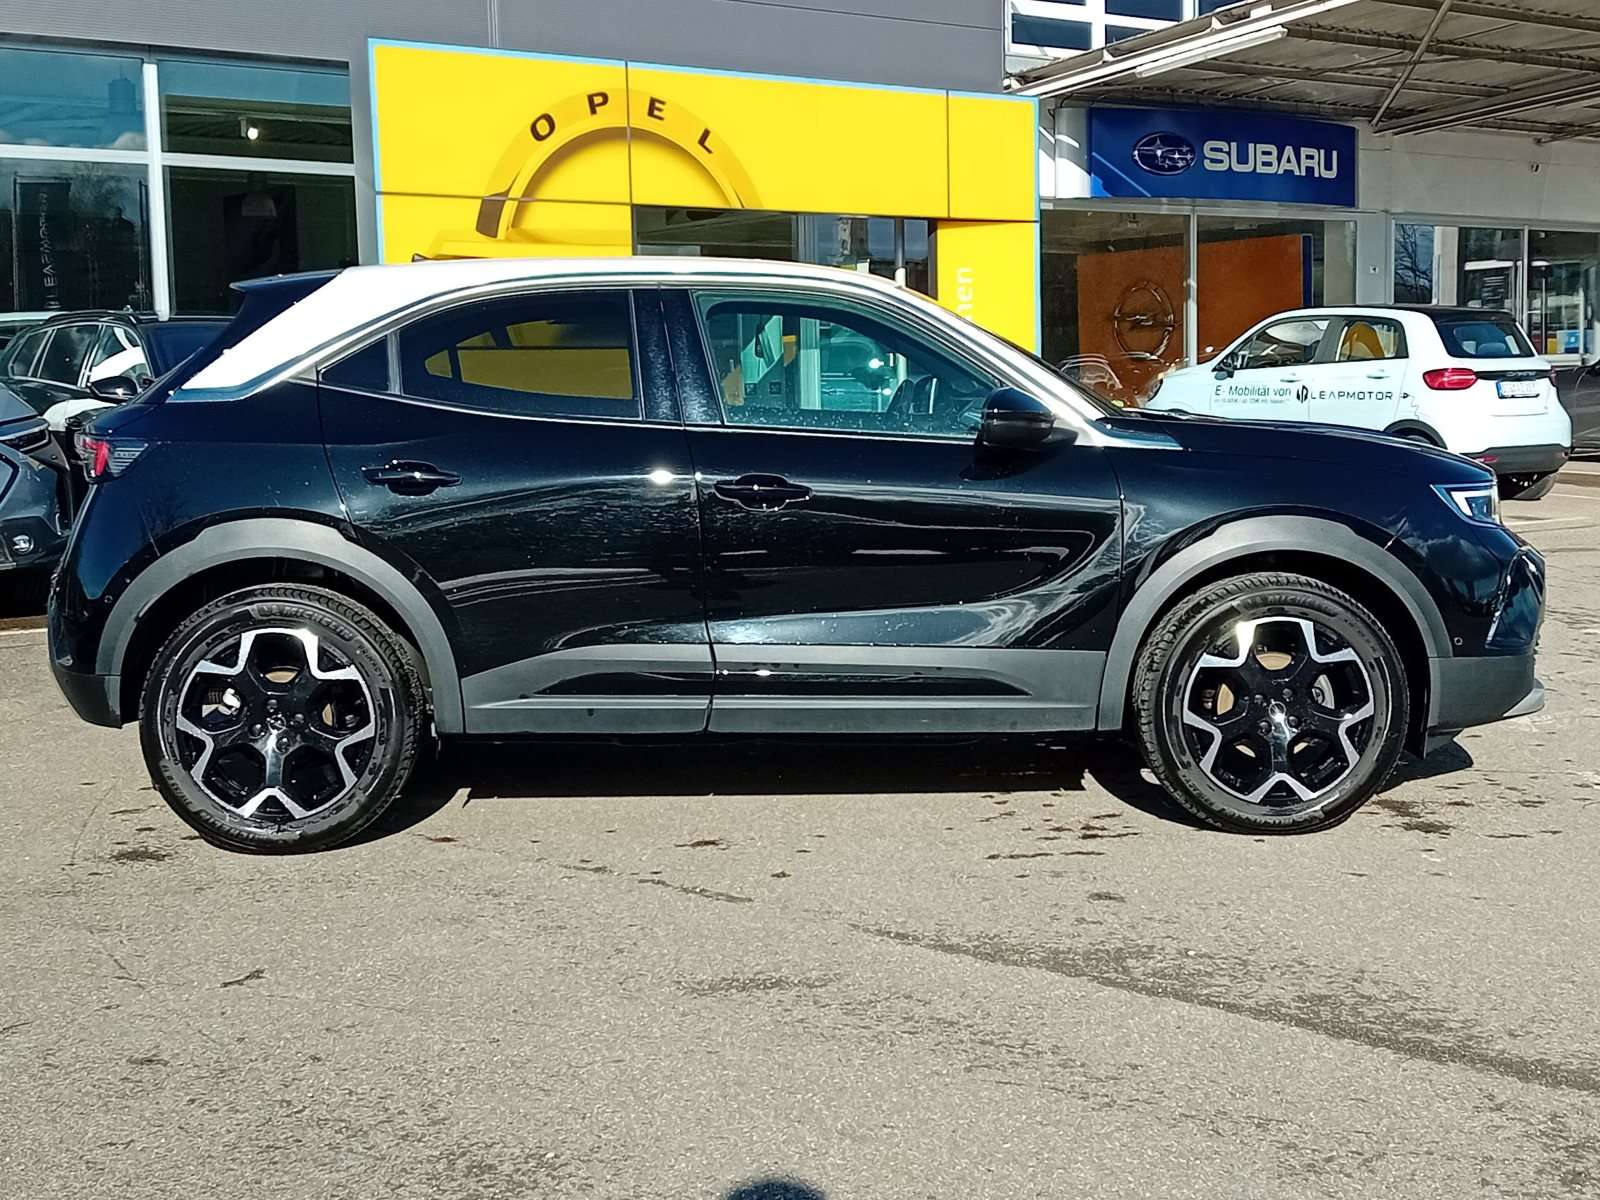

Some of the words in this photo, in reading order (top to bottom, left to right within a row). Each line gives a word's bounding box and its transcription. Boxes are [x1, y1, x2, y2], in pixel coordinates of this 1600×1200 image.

[530, 91, 713, 154] OPEL
[1203, 140, 1338, 179] SUBARU
[1228, 385, 1271, 396] Mobilität
[1273, 388, 1292, 397] von
[1310, 390, 1393, 401] LEAPMOTOR
